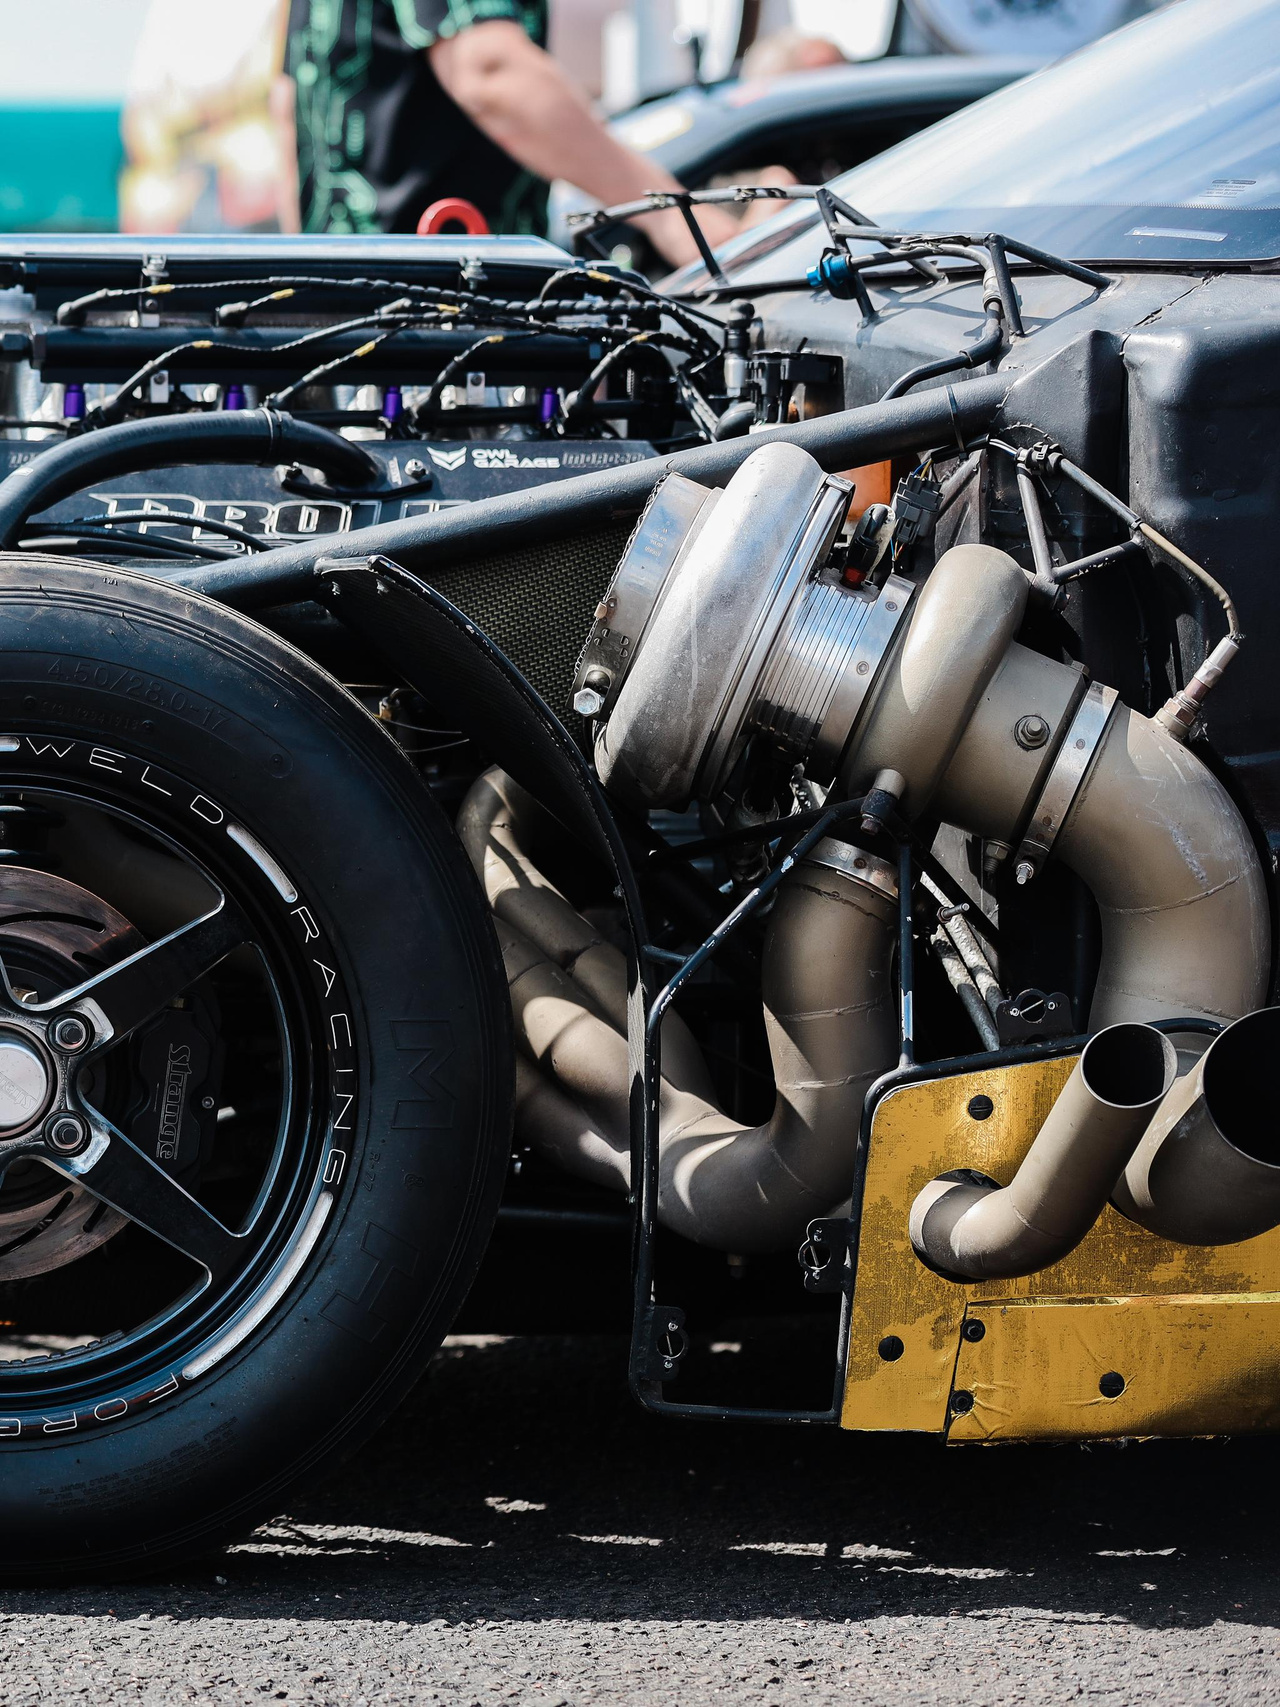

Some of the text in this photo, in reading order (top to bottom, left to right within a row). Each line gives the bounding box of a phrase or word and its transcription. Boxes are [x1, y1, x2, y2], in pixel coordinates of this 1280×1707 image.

[471, 448, 517, 459] OWL
[473, 457, 560, 469] GARAGE
[47, 658, 232, 731] 4.50/28.0-17
[26, 736, 223, 825] WELD
[289, 904, 353, 1187] RACING
[389, 1017, 456, 1132] M
[157, 1043, 192, 1160] Strange
[318, 1220, 419, 1345] H
